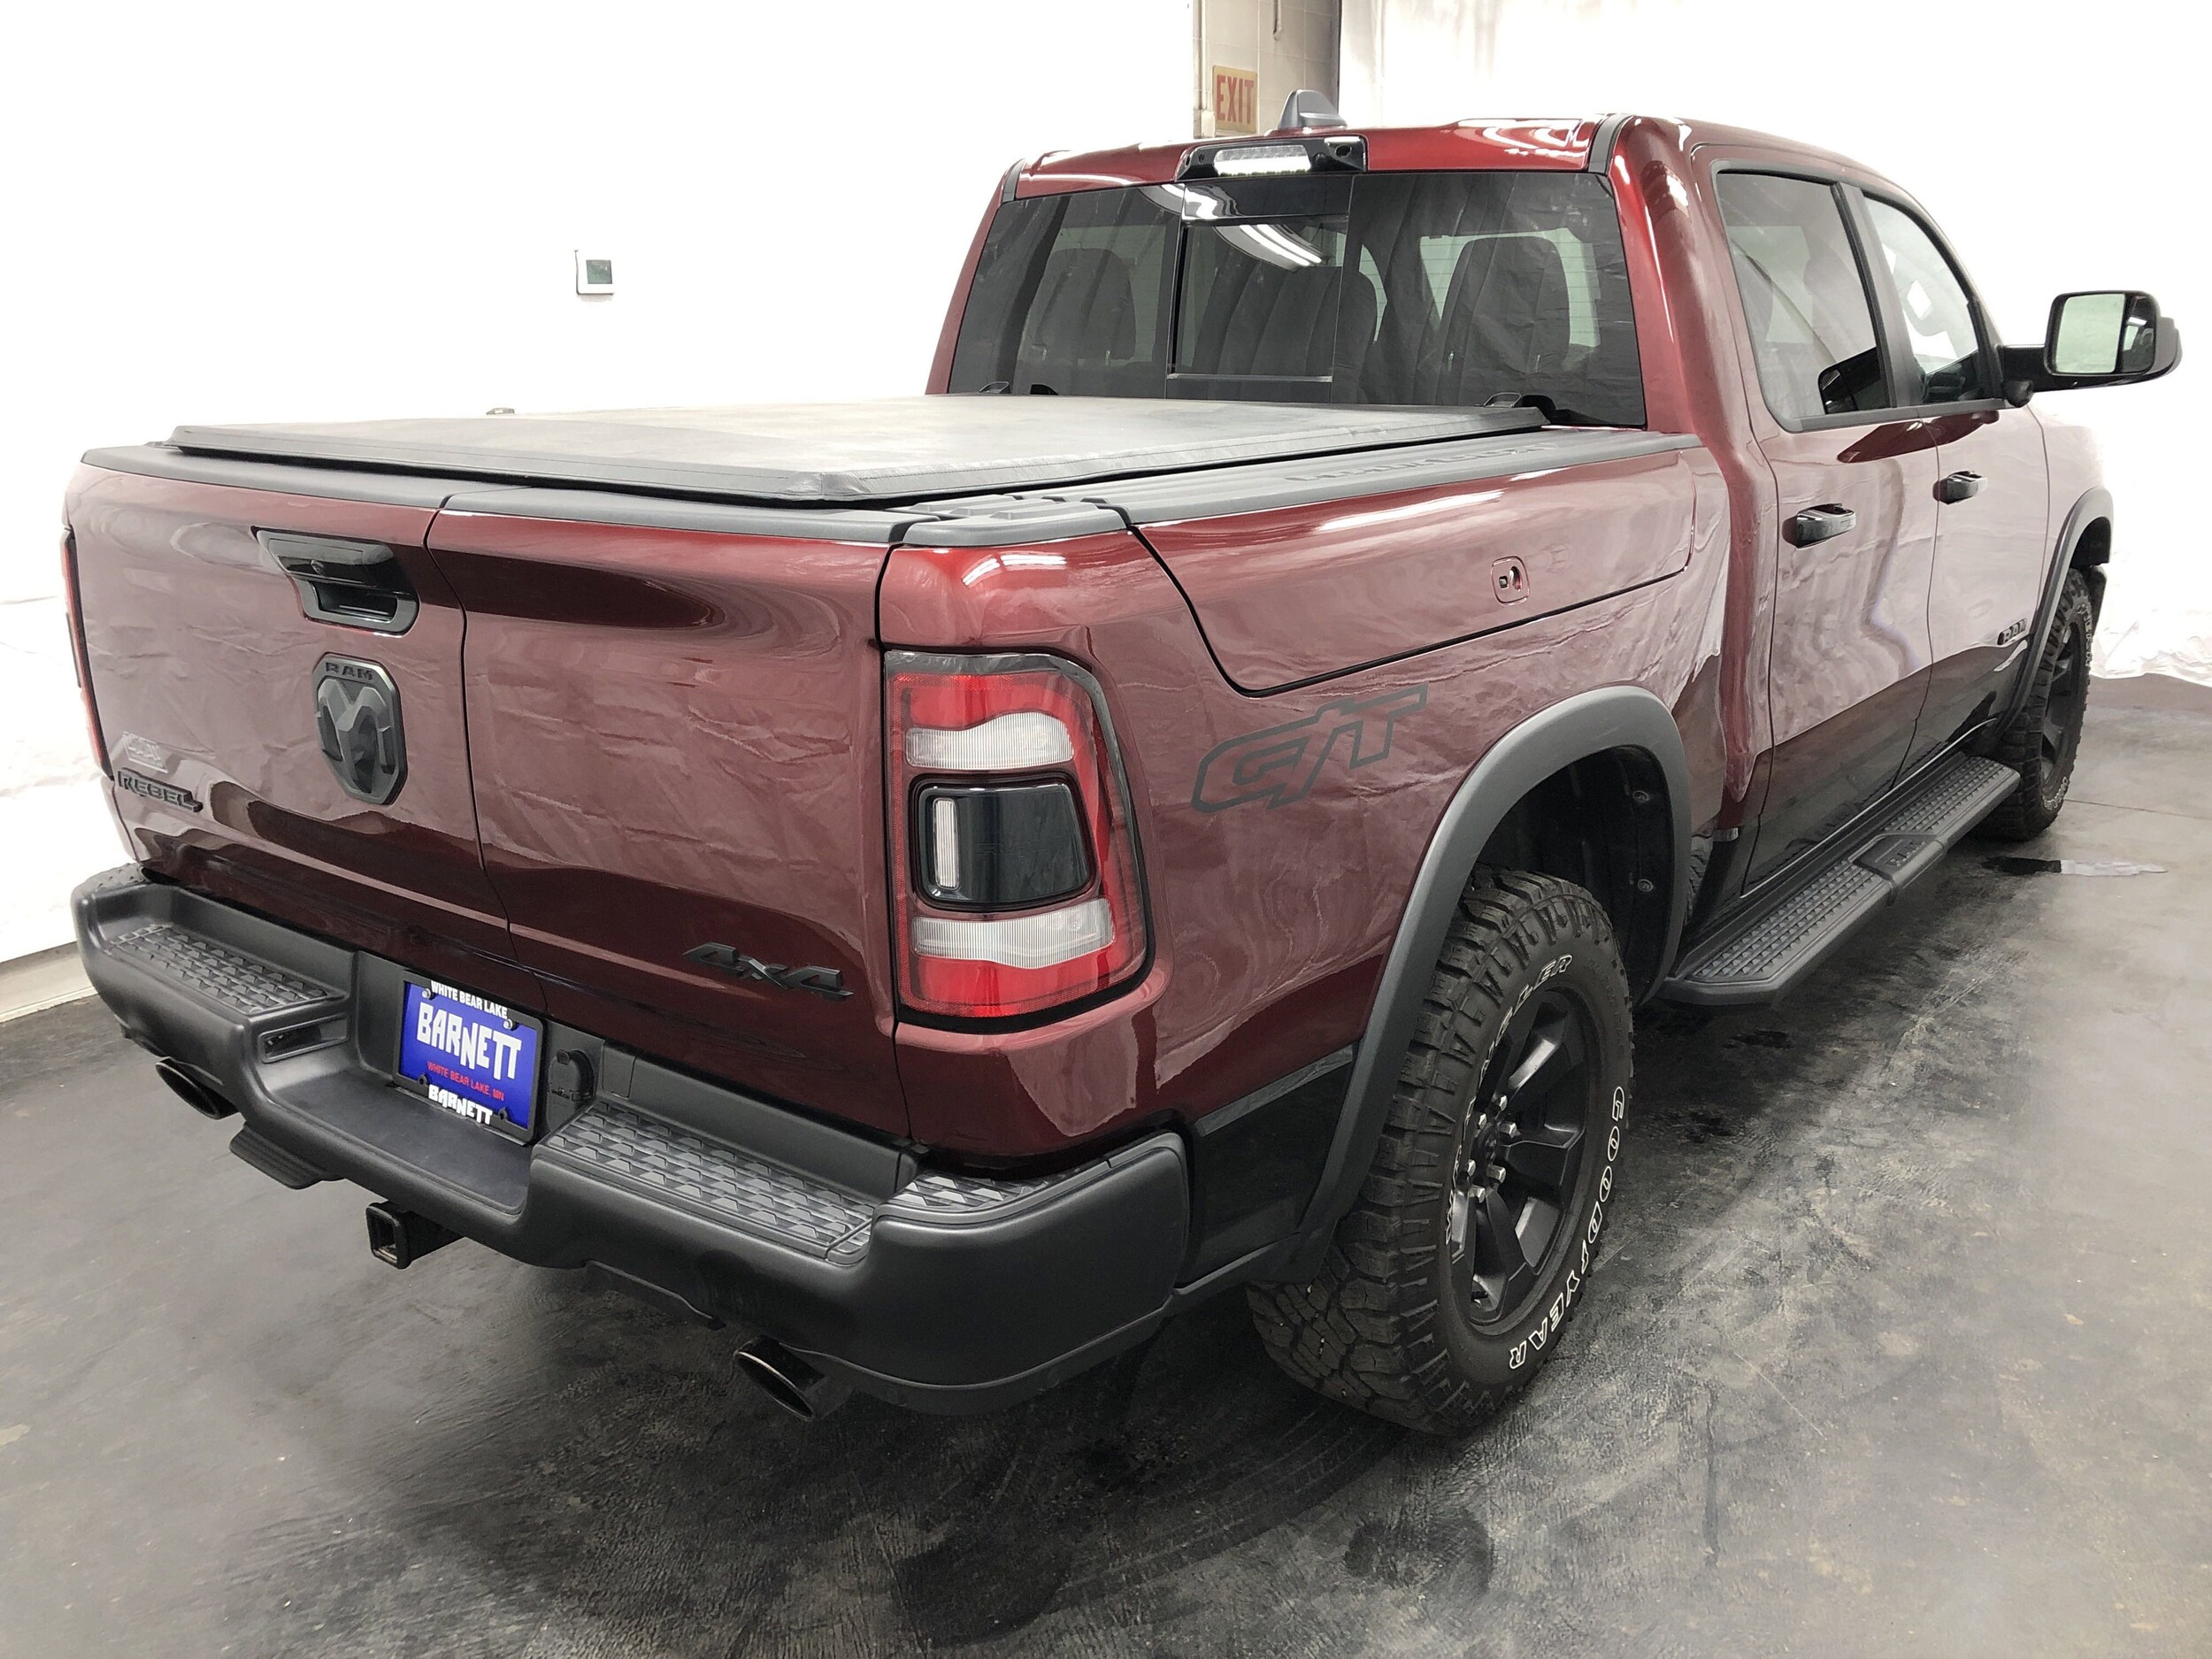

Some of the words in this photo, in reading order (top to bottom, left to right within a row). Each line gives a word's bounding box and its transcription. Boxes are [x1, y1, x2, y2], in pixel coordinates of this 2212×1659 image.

[1216, 73, 1255, 125] EXIT
[1997, 618, 2027, 646] RAM
[325, 662, 373, 680] RAM
[117, 767, 204, 813] REBEL
[430, 979, 458, 1002] WHITE
[459, 991, 483, 1011] BEAR
[484, 1000, 508, 1019] LAKE
[417, 1002, 522, 1080] BARNETT
[426, 1061, 449, 1079] WHITE
[449, 1071, 470, 1087] BEAR
[428, 1084, 494, 1125] BARNETT
[1509, 1086, 1625, 1370] GOODYEAR
